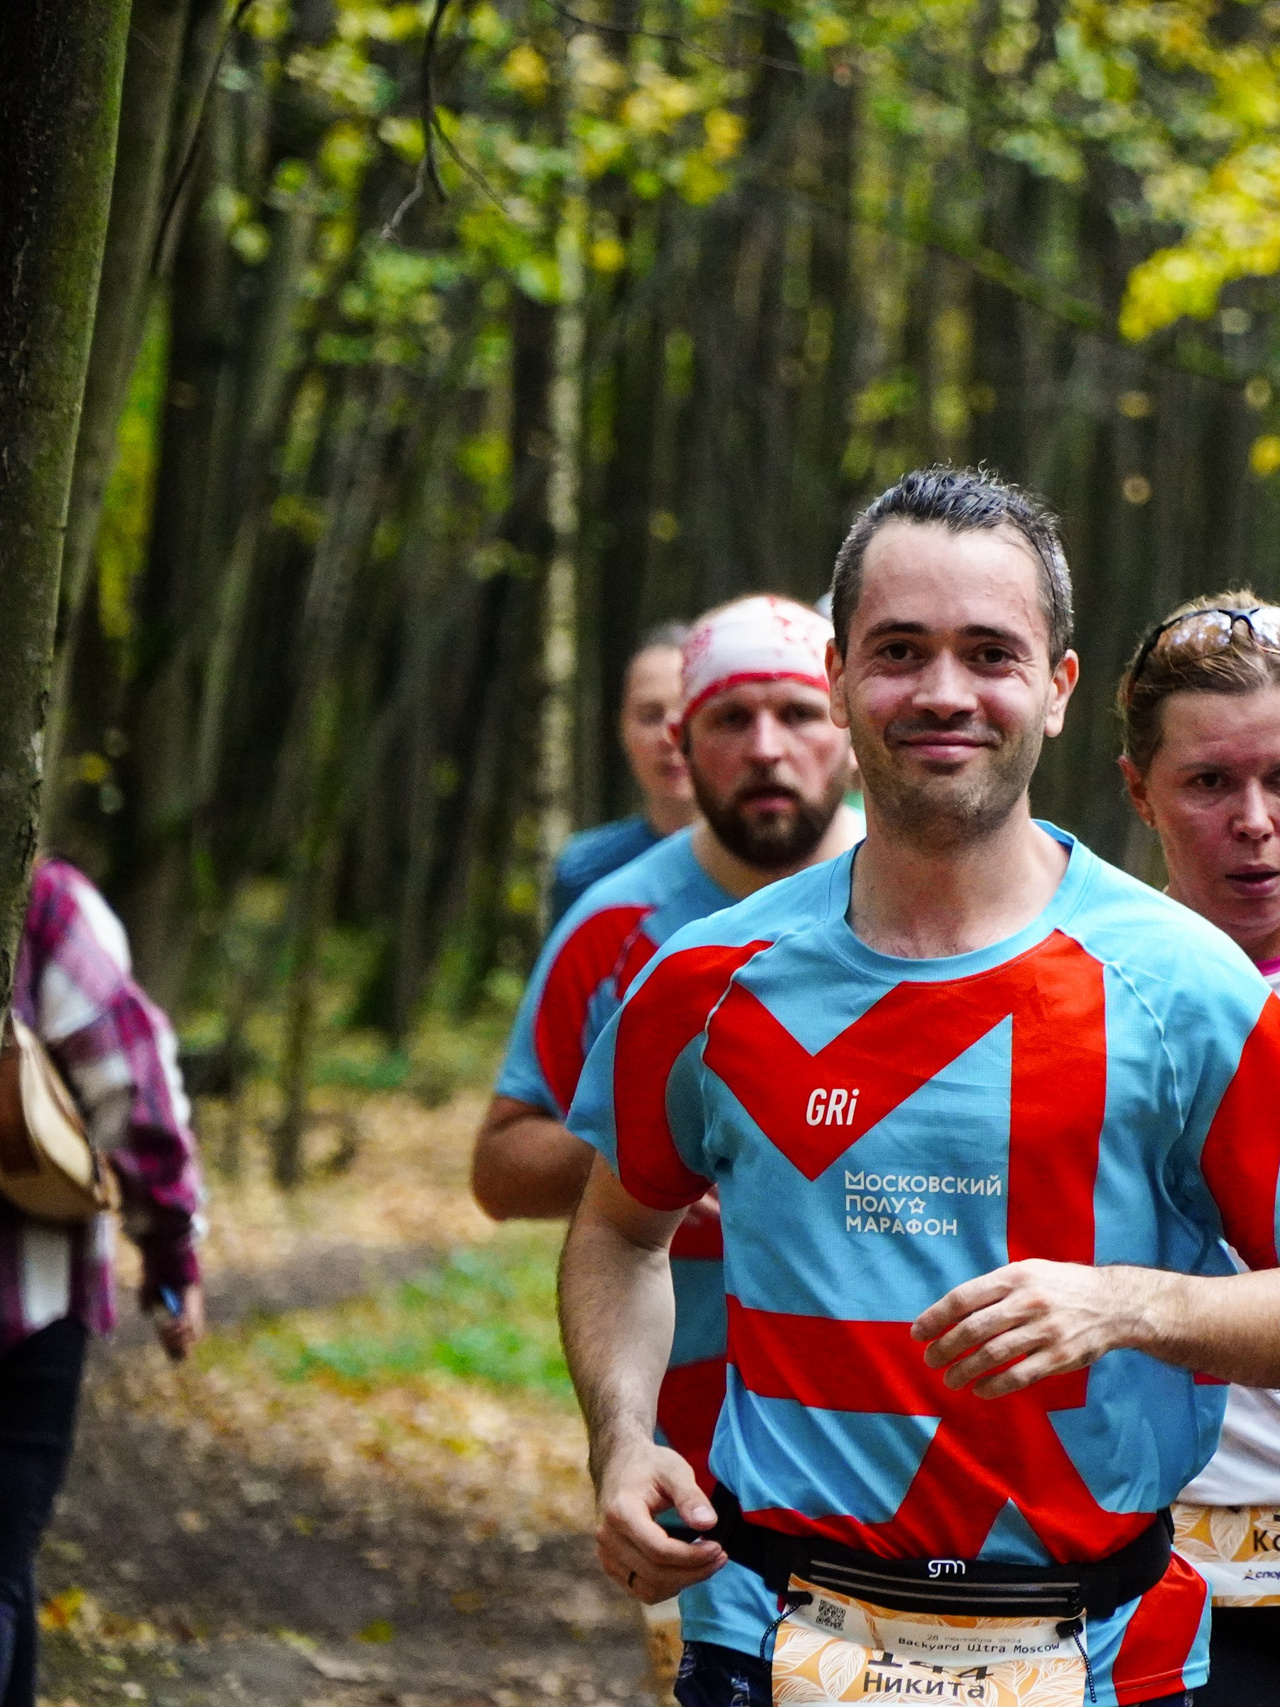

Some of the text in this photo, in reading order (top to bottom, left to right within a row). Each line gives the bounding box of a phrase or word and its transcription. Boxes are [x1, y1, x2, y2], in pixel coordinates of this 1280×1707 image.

[806, 1088, 860, 1126] GRi
[845, 1195, 907, 1214] ПОЛУ
[846, 1215, 958, 1236] МАРАФОН
[898, 1637, 1060, 1654] Backyard Ultra Moscow
[863, 1672, 985, 1699] Никита
